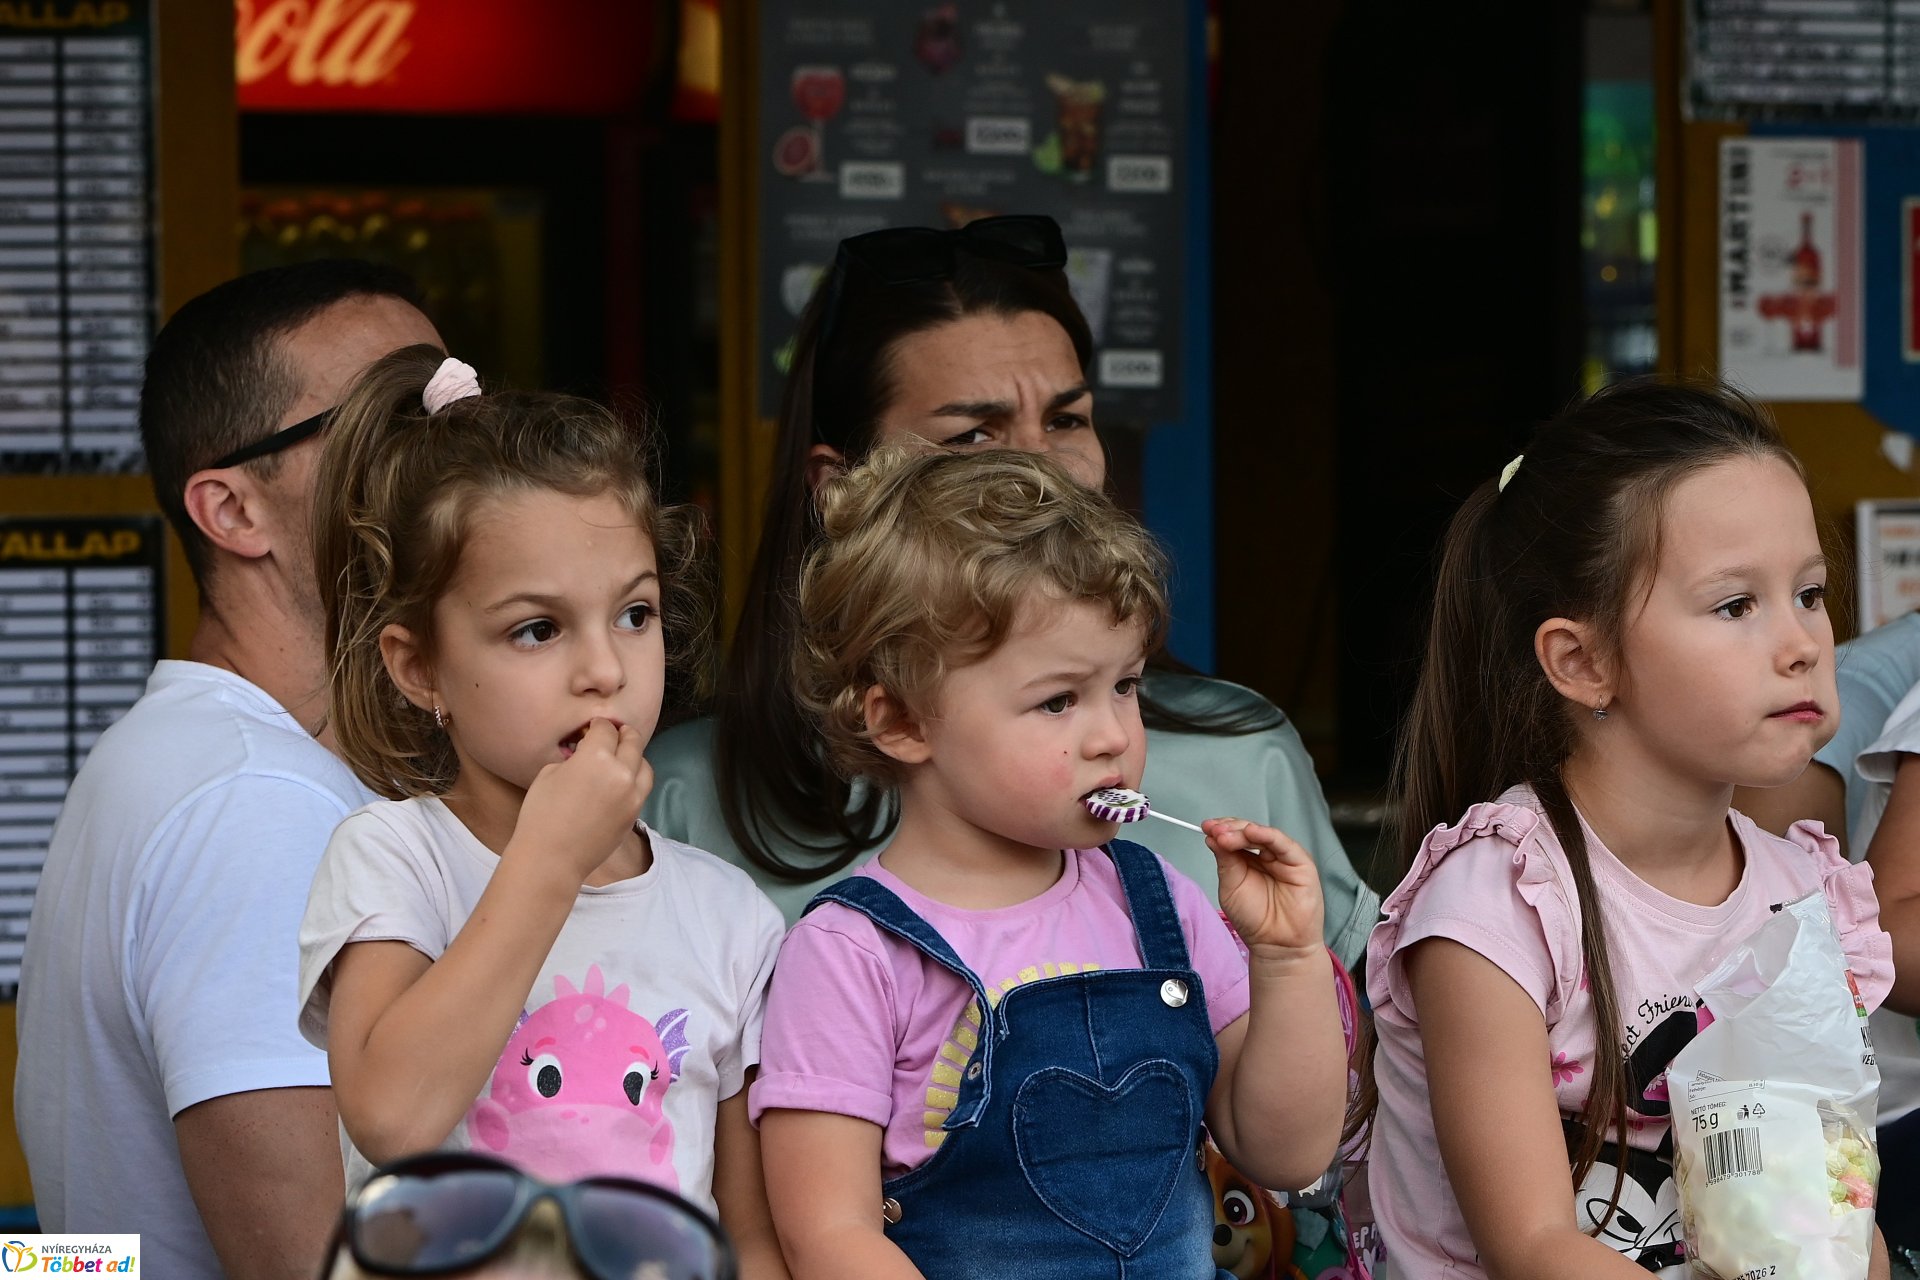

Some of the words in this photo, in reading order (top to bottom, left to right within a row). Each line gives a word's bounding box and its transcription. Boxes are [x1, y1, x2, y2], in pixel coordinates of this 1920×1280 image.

[235, 0, 412, 87] ola
[0, 529, 142, 560] ALLAP
[1638, 993, 1693, 1024] Frien
[1692, 1114, 1707, 1133] 75
[1709, 1112, 1719, 1129] g
